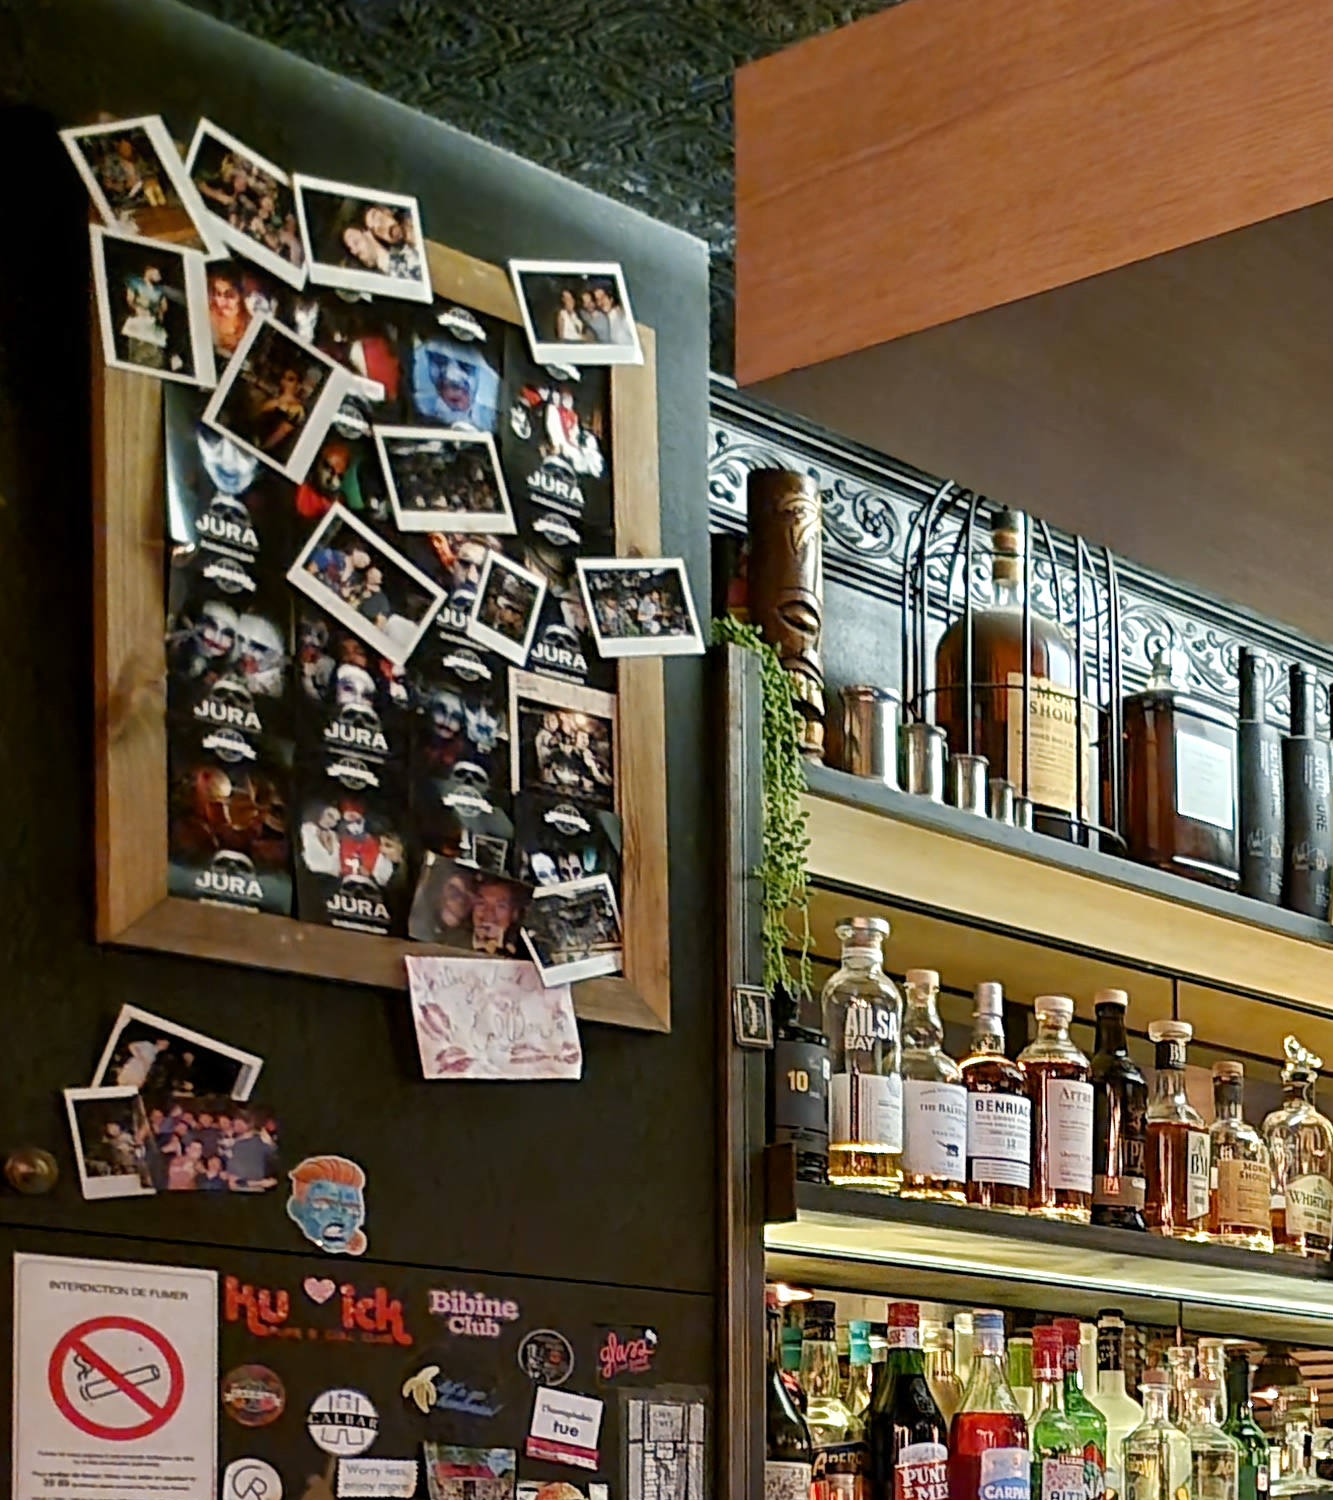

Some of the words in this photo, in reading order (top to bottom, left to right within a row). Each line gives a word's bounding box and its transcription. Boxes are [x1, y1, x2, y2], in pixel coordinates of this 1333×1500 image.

[527, 469, 584, 505] JURA
[195, 513, 260, 548] JURA
[436, 604, 470, 630] JU
[531, 641, 588, 671] JURA
[193, 699, 262, 730] JURA
[1030, 700, 1079, 725] SHOU
[323, 721, 389, 751] JURA
[195, 870, 264, 899] JURA
[326, 893, 391, 920] JURA
[845, 1006, 899, 1042] AILSA
[844, 1036, 875, 1051] BAY
[787, 1070, 809, 1092] 10
[975, 1099, 1028, 1116] BENRIAC
[1103, 1177, 1121, 1193] IPA
[49, 1280, 130, 1297] INTERDICTION
[131, 1288, 147, 1298] DE
[149, 1289, 189, 1301] FUMER
[428, 1289, 520, 1320] Bibine
[447, 1315, 501, 1338] Club
[307, 1411, 379, 1430] CALBAR
[553, 1420, 579, 1438] tue
[344, 1463, 383, 1478] Worry
[812, 1451, 864, 1479] APERO
[902, 1467, 948, 1488] PUNT
[378, 1483, 409, 1493] more
